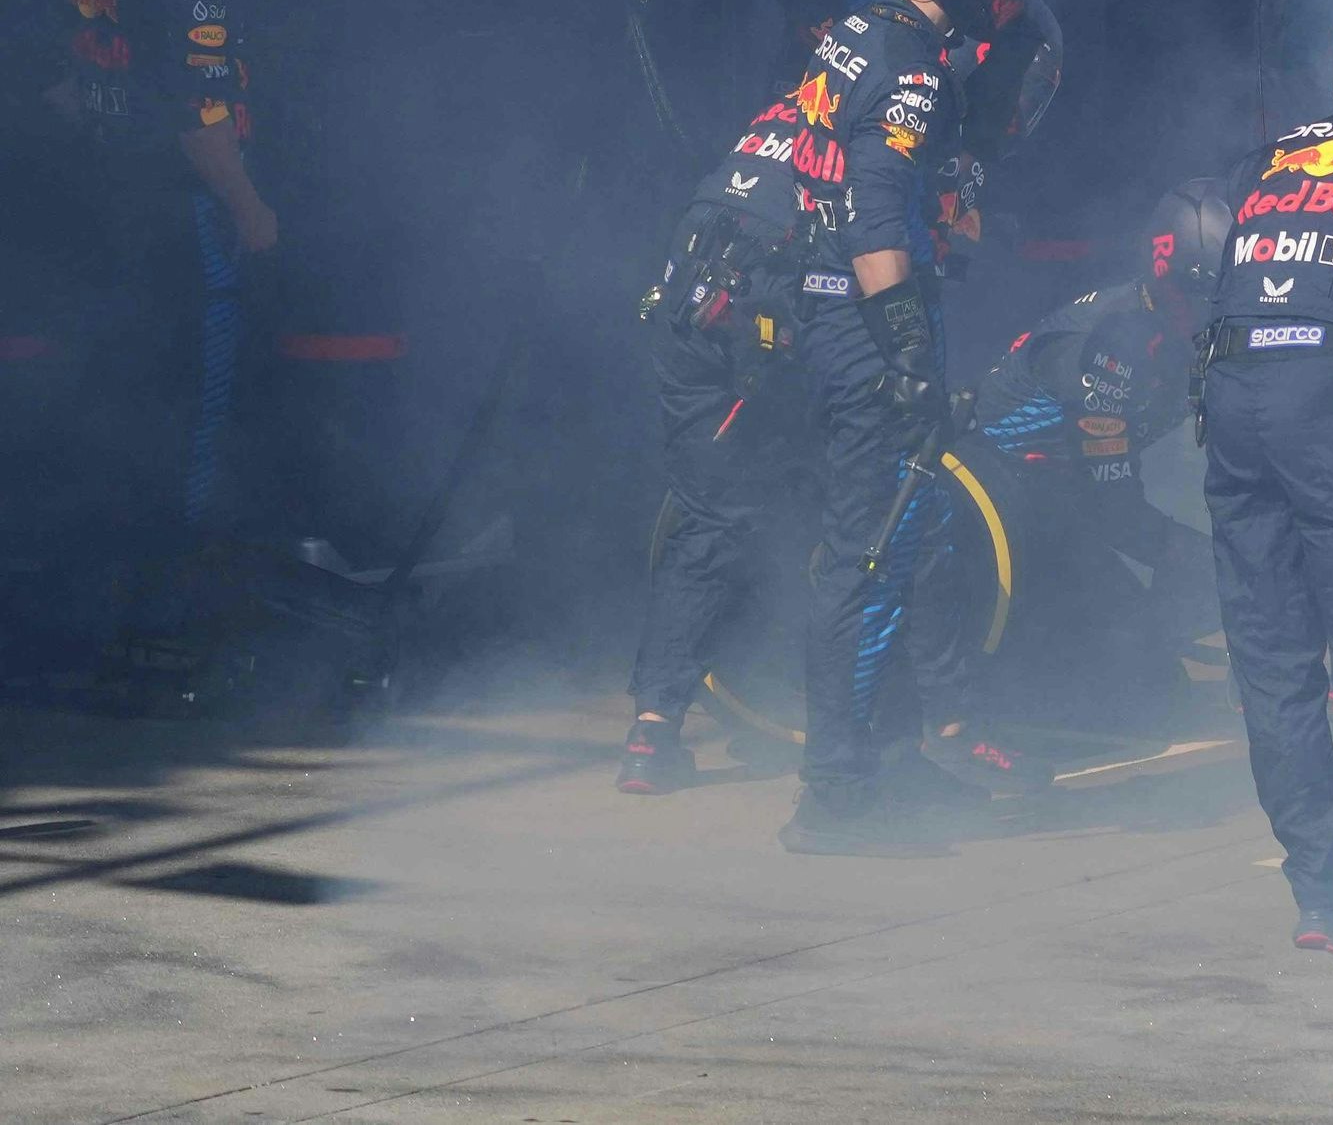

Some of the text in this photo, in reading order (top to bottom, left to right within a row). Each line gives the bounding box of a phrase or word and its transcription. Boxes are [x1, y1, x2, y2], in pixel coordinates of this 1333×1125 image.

[898, 72, 939, 91] Mobil
[905, 114, 927, 135] Sui
[1235, 231, 1318, 266] Mobil
[1251, 326, 1322, 346] sparco
[1093, 352, 1132, 379] Mobil
[1081, 373, 1128, 400] Claro
[1091, 461, 1132, 481] VISA
